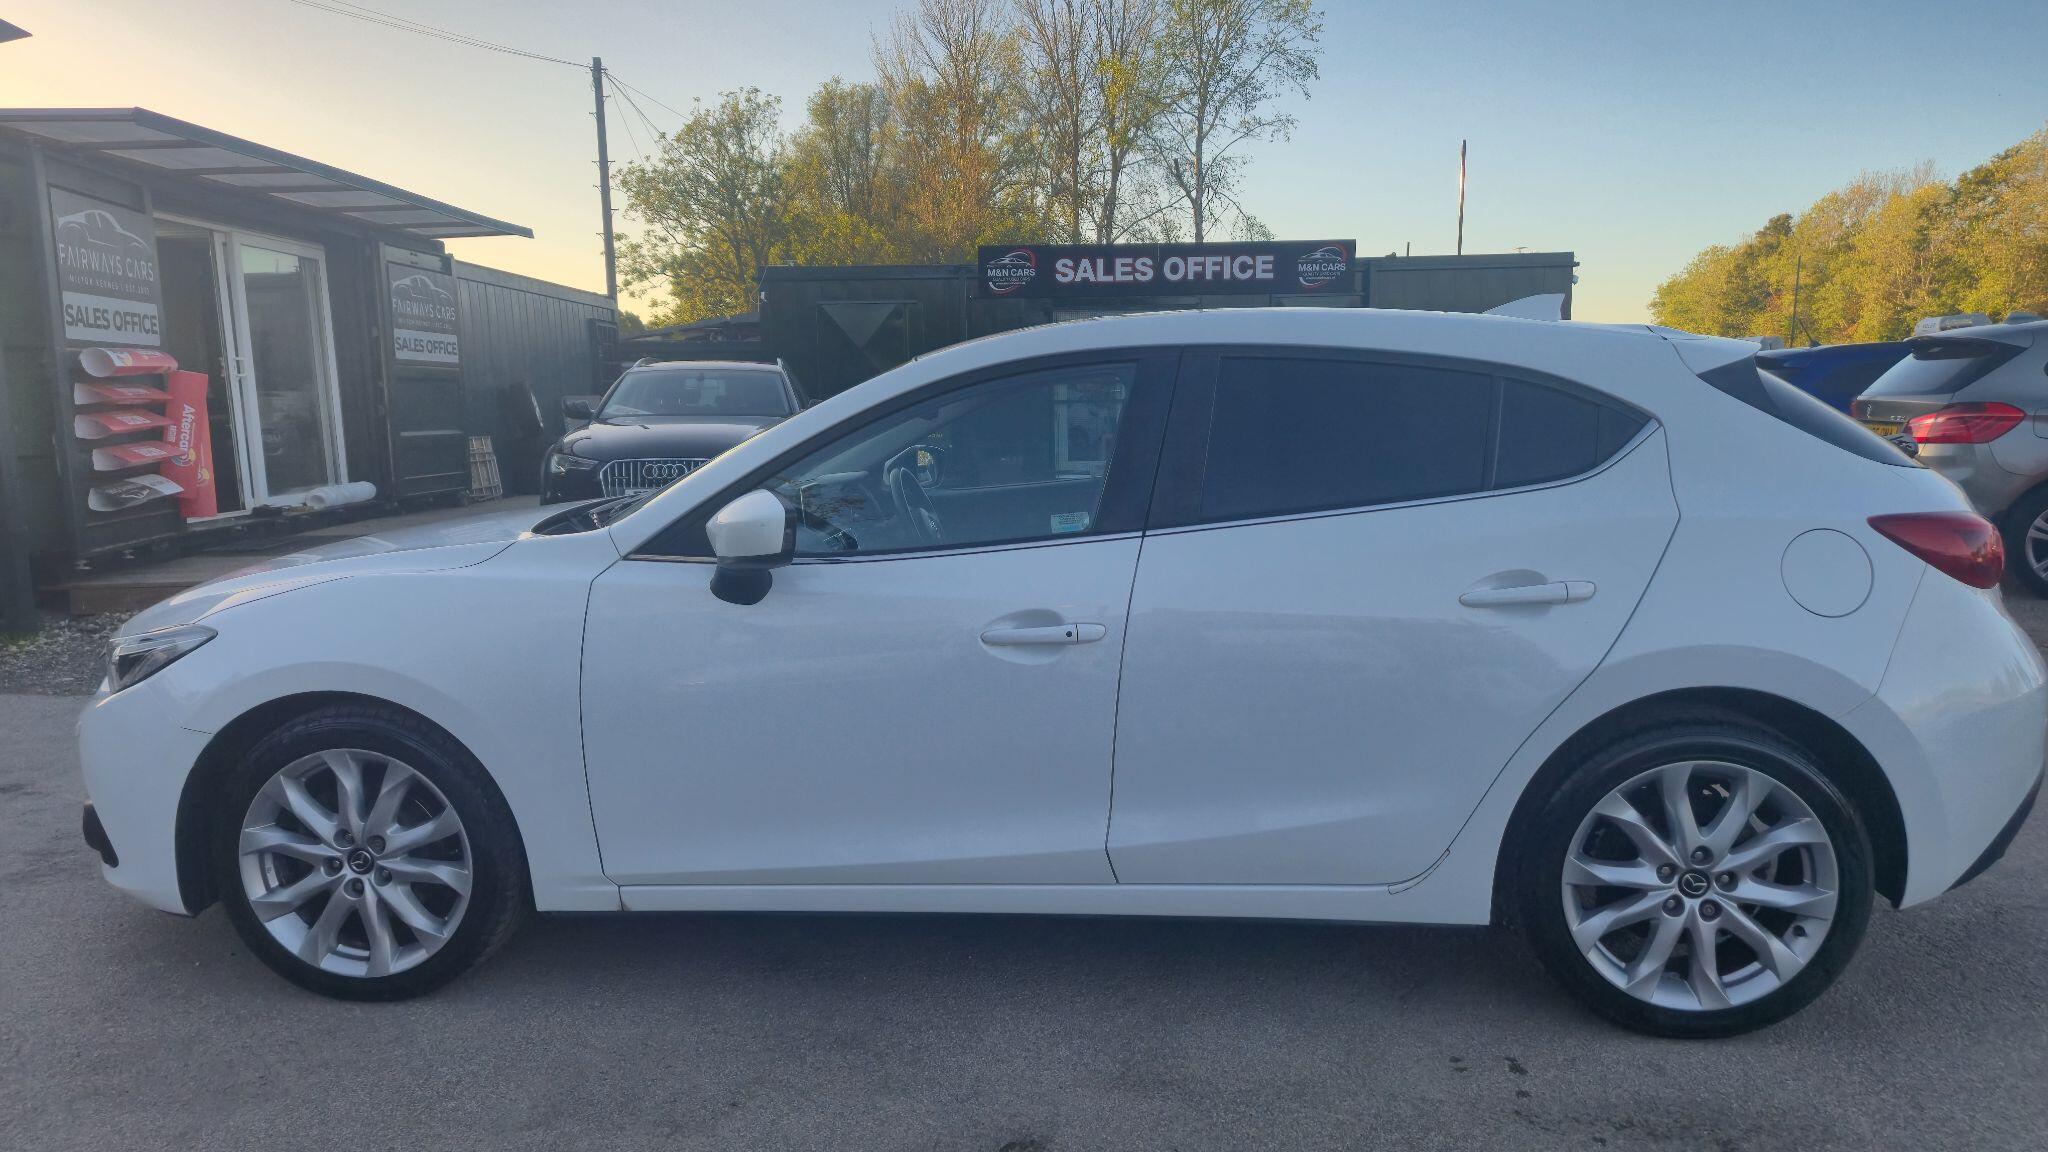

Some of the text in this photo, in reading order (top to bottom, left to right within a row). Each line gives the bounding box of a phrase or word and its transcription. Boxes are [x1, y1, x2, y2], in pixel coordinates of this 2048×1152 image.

[59, 243, 154, 282] FAIRWAYS CARS
[987, 268, 1036, 277] M&N CARS
[1055, 255, 1274, 283] SALES OFFICE
[1298, 263, 1346, 272] M&N CARS
[65, 304, 160, 336] SALES OFFICE
[392, 299, 456, 320] FAIRWAYS CARS
[395, 336, 458, 355] SALES OFFICE
